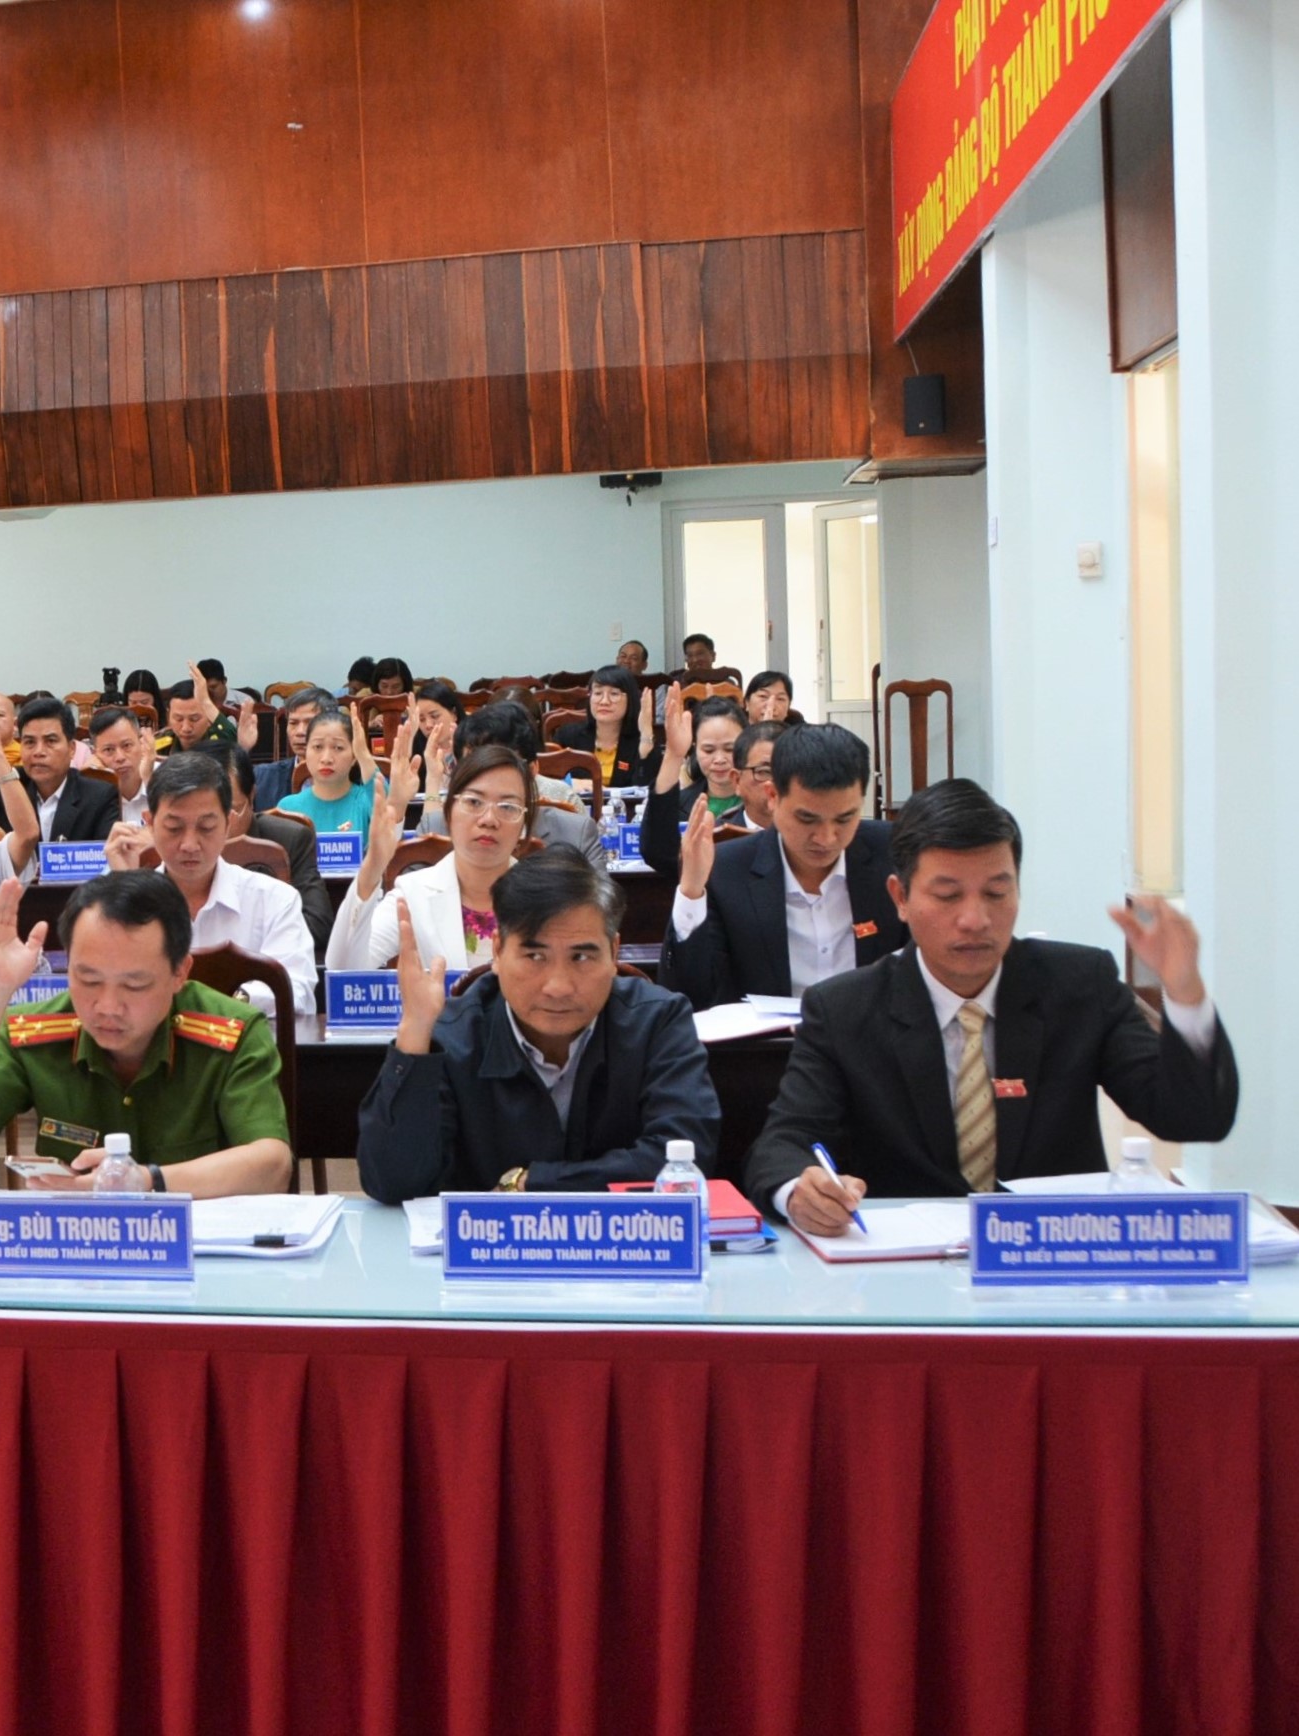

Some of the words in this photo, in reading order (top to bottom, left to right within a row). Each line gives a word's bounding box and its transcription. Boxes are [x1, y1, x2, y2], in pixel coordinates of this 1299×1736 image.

[981, 65, 1000, 187] BỘ
[344, 984, 366, 1001] Bà:
[370, 984, 383, 1000] VI
[19, 1211, 52, 1240] BÙI
[57, 1216, 120, 1246] TRỌNG
[125, 1210, 177, 1242] TUẤN
[458, 1209, 505, 1243] Ông:
[511, 1206, 568, 1241] TRẦN
[574, 1211, 603, 1241] VŨ
[609, 1209, 684, 1241] CƯỜNG
[986, 1211, 1032, 1246] Ông:
[1037, 1213, 1122, 1242] TRƯƠNG
[1179, 1208, 1232, 1241] BÌNH
[471, 1247, 490, 1262] ĐẠI
[493, 1244, 519, 1260] BIỂU
[555, 1246, 593, 1261] THÀNH
[595, 1245, 618, 1261] PHỐ
[654, 1249, 670, 1261] XII
